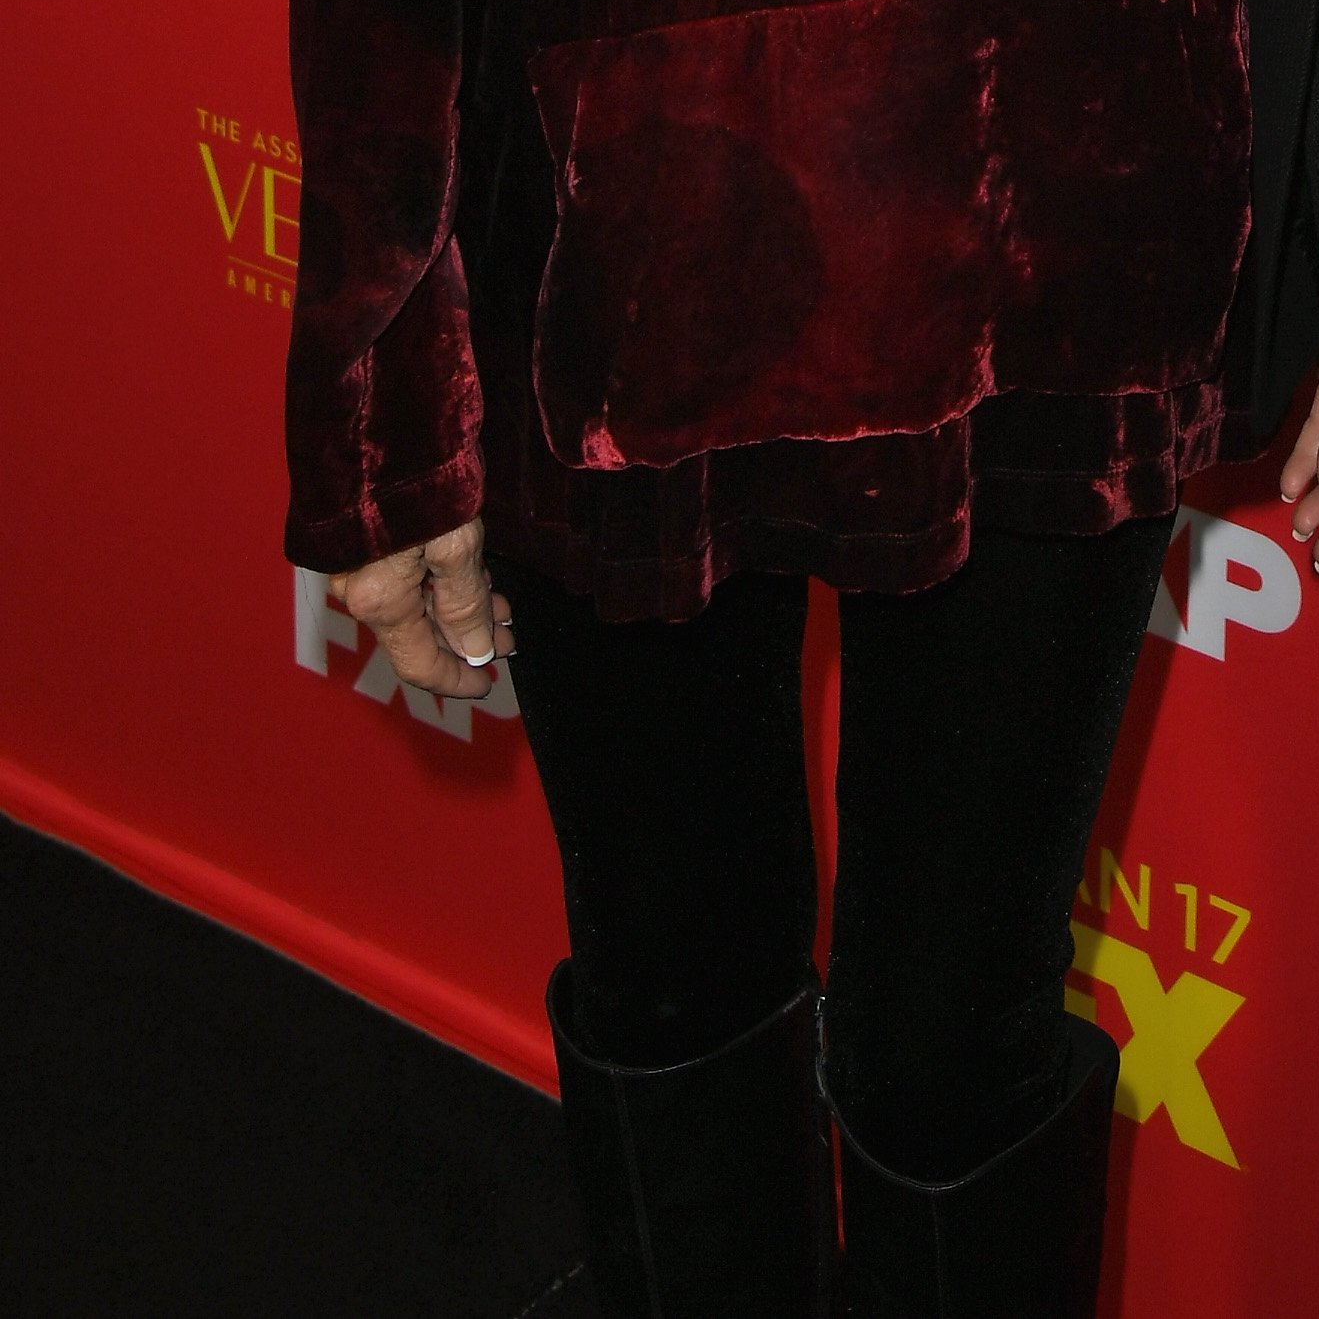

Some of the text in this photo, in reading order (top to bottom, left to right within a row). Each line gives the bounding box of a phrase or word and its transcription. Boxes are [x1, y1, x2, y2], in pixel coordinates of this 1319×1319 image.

[197, 108, 240, 142] THE
[1147, 505, 1302, 661] P
[1175, 883, 1252, 965] 17
